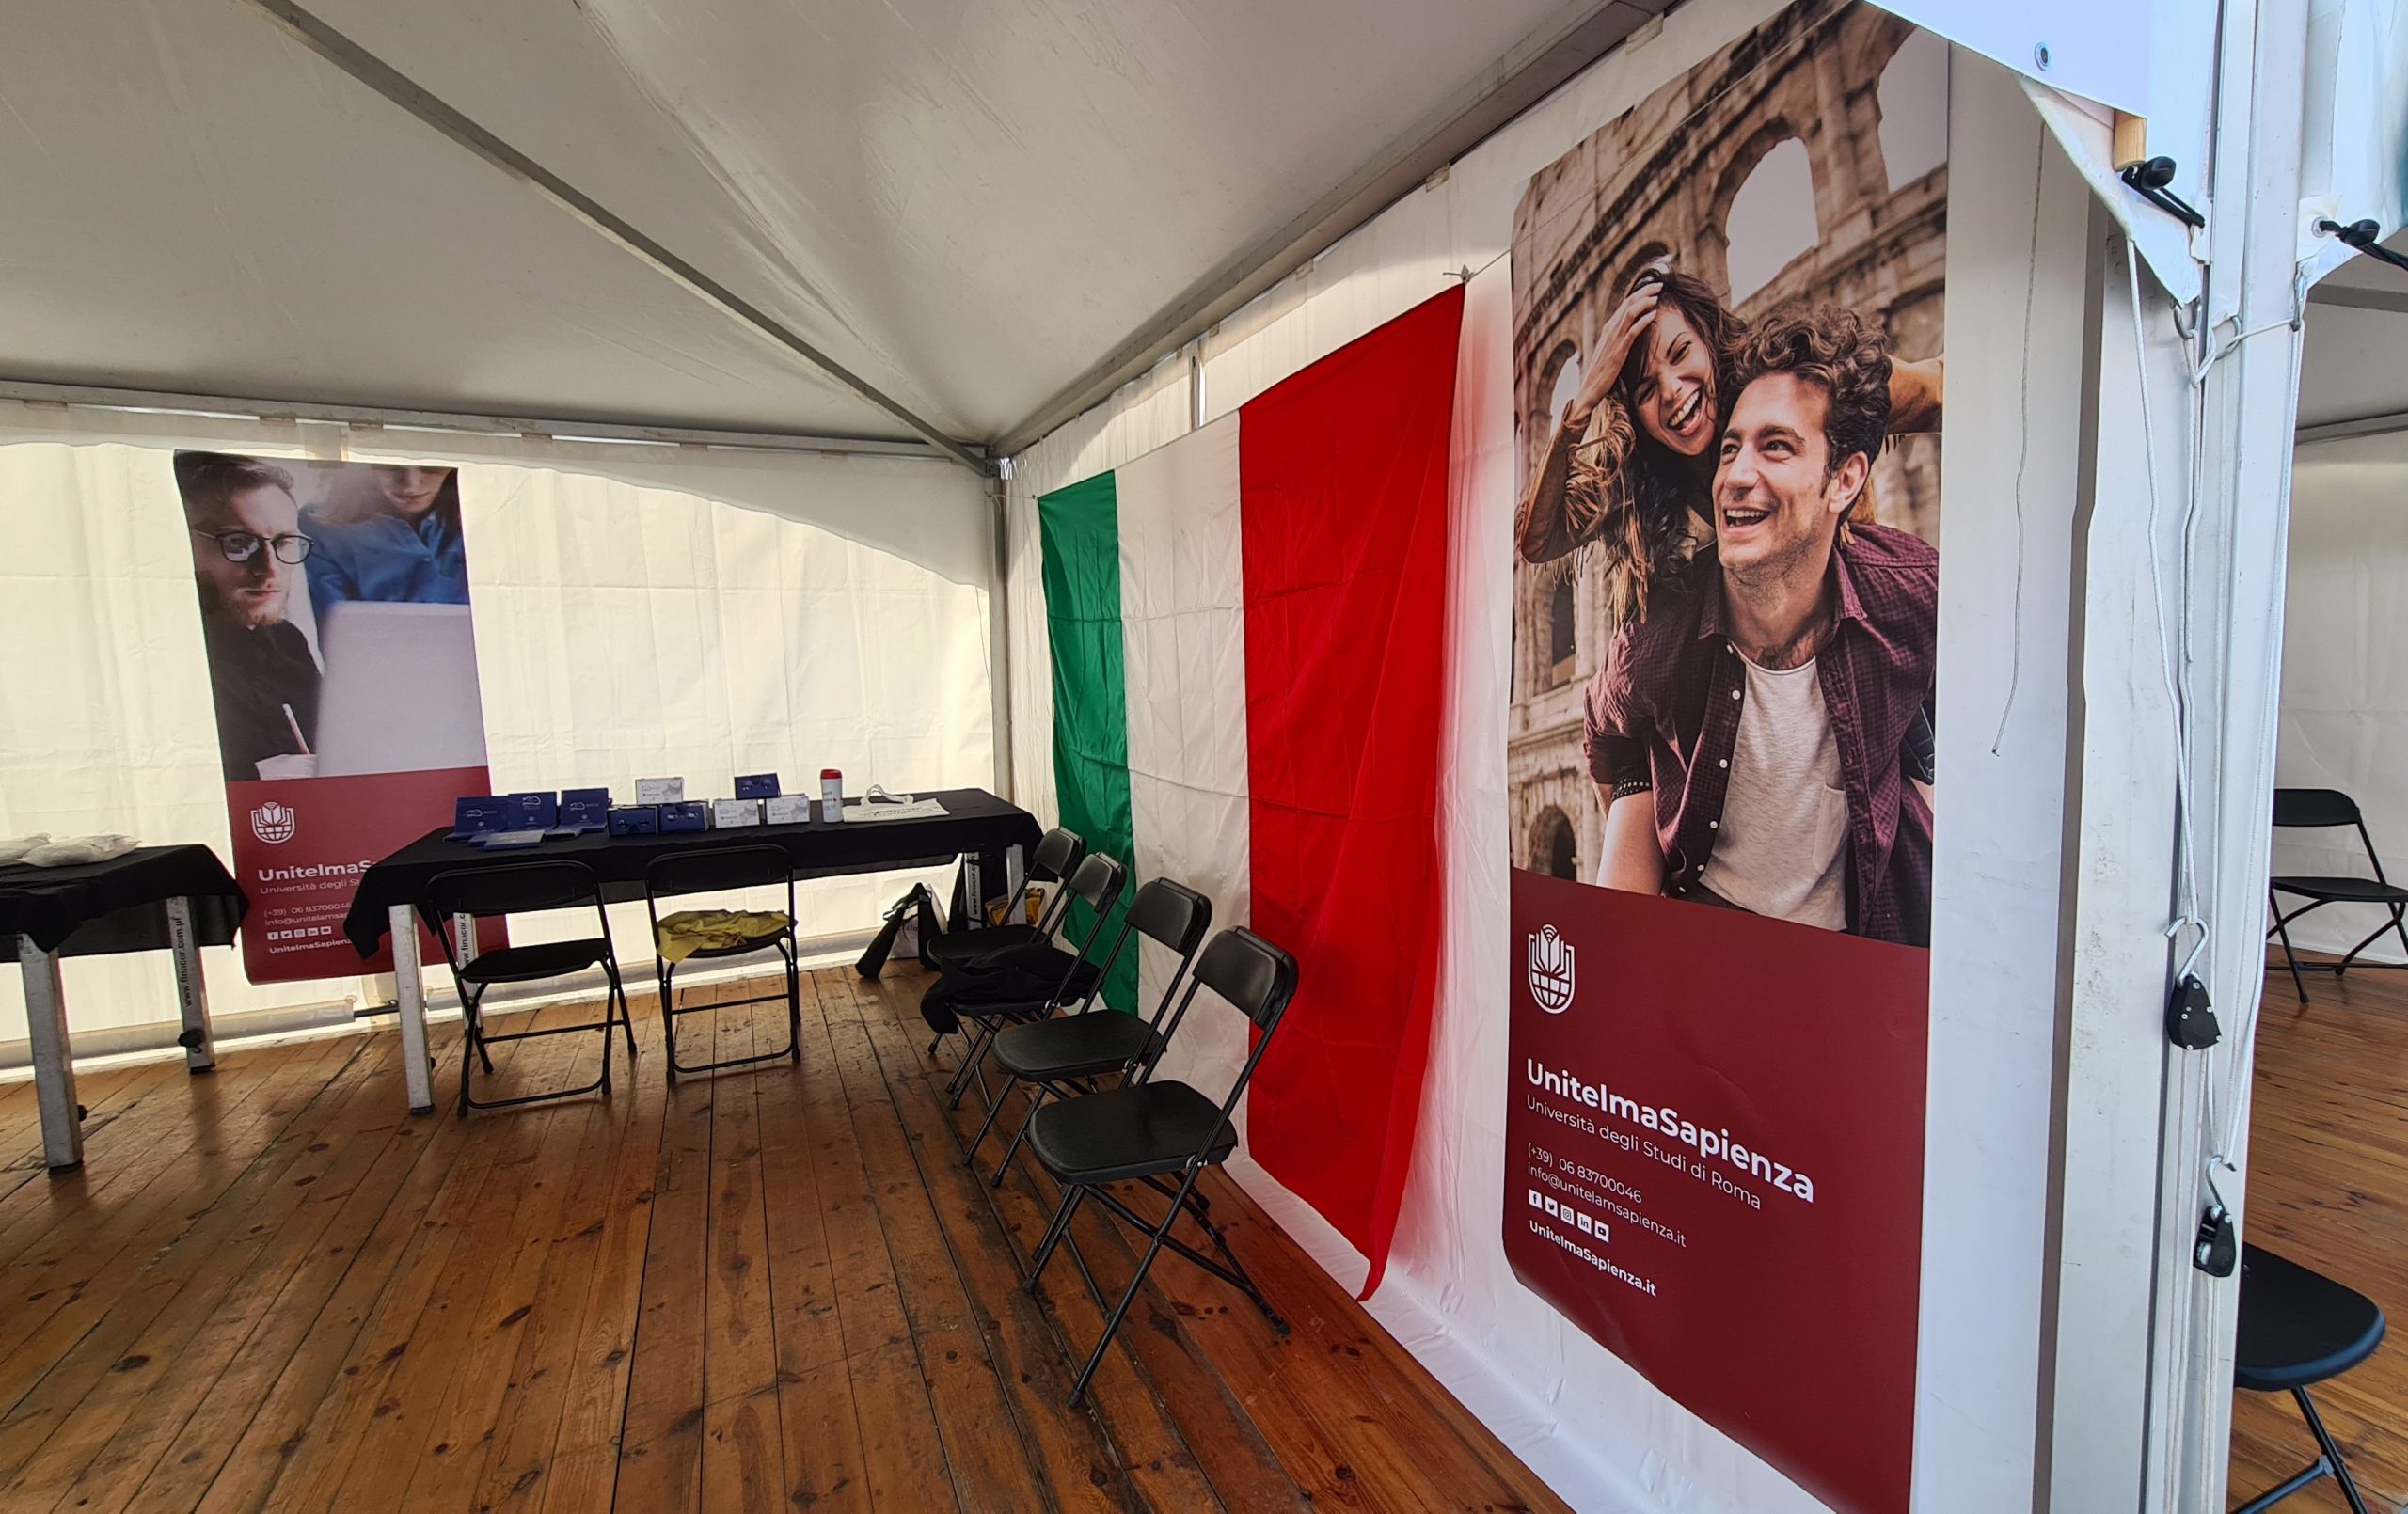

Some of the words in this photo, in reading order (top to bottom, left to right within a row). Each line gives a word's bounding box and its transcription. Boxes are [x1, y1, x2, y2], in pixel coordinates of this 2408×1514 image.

[258, 860, 377, 882] UnitelmaS
[260, 882, 317, 894] Università
[319, 879, 348, 890] degli
[263, 908, 287, 918] (+39)
[291, 906, 304, 914] 06
[1527, 1057, 1815, 1204] UnitelmaSapienza
[1527, 1094, 1596, 1135] Università
[1598, 1123, 1640, 1153] degli
[1642, 1141, 1687, 1171] Studi
[1690, 1160, 1707, 1182] di
[1710, 1170, 1762, 1210] Roma
[1527, 1143, 1554, 1169] (+39)
[1558, 1157, 1576, 1175] 06
[1576, 1163, 1642, 1204] 83700046
[1527, 1162, 1687, 1248] info@unitelamsapienza.it
[1529, 1219, 1657, 1298] UnitelmaSapienza.it
